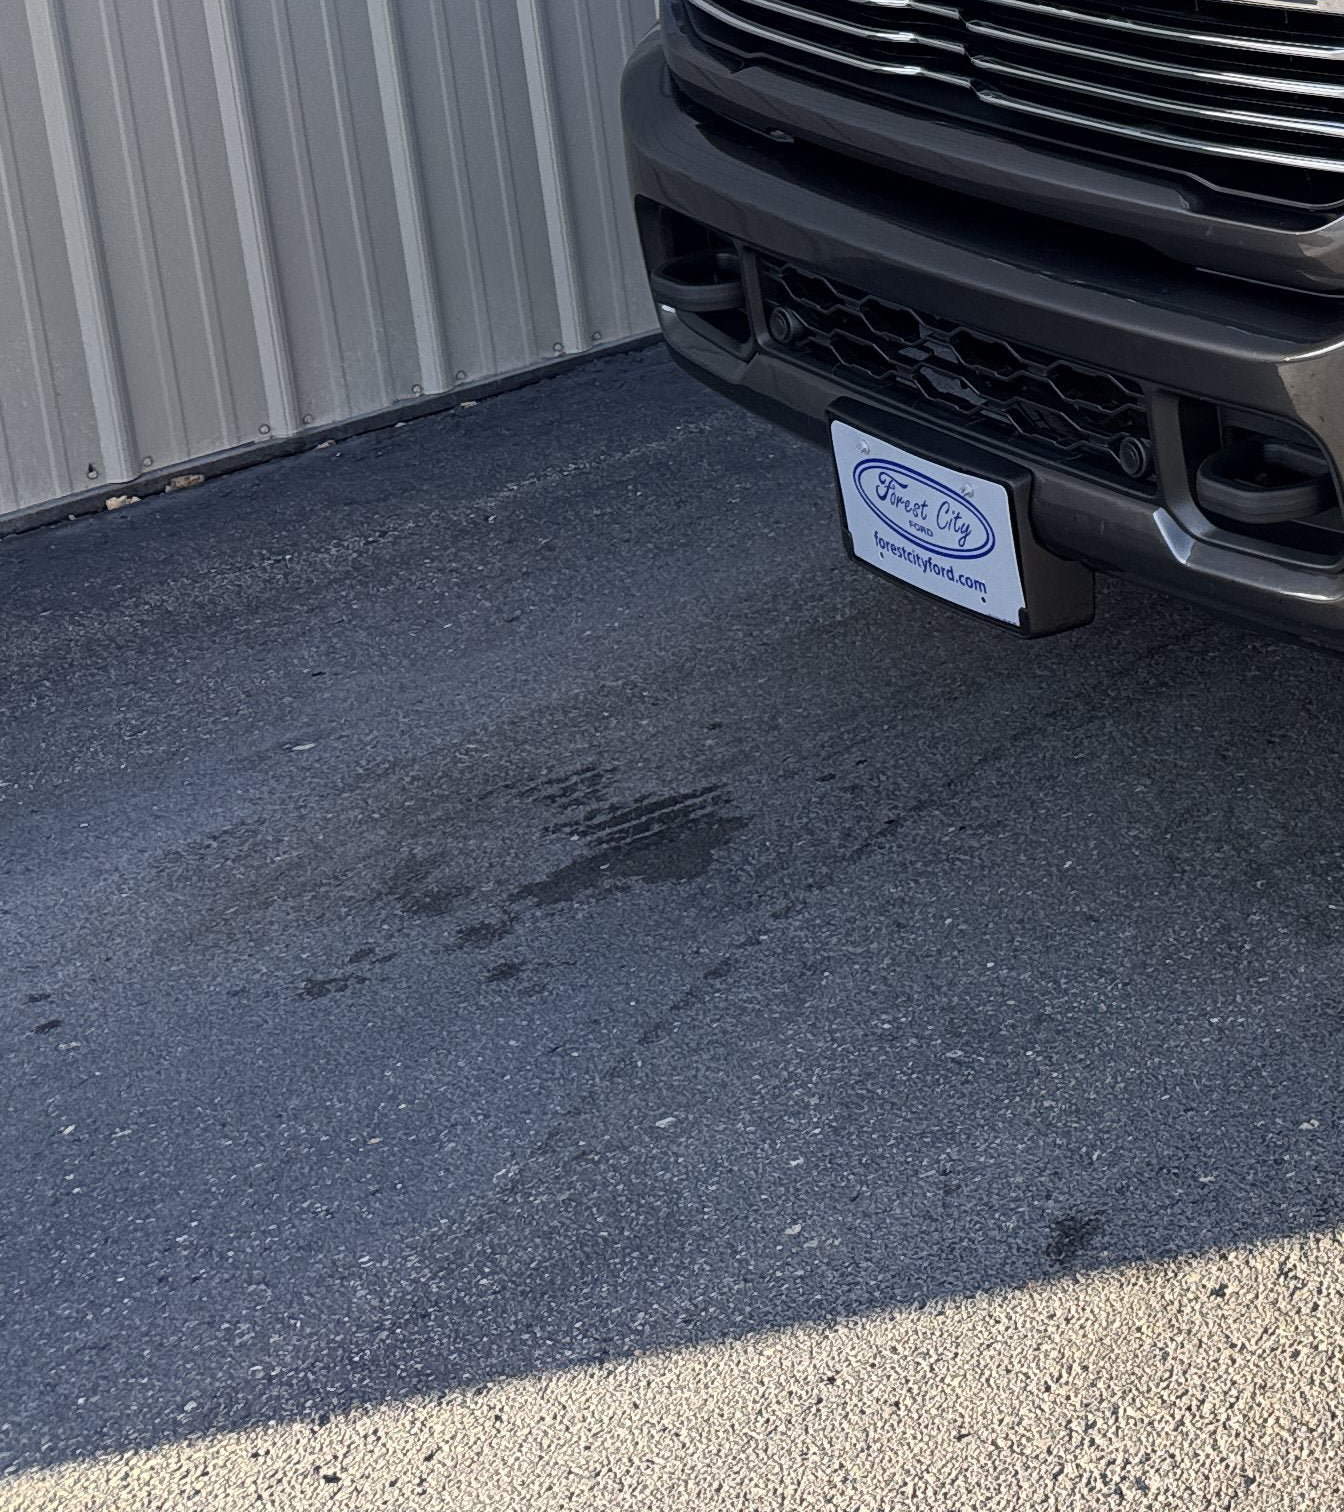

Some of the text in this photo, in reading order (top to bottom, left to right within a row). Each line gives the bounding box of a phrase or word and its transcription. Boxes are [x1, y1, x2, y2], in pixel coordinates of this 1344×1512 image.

[875, 471, 972, 547] Forest City
[908, 520, 934, 538] FORD
[874, 530, 988, 594] forestcityford.com
